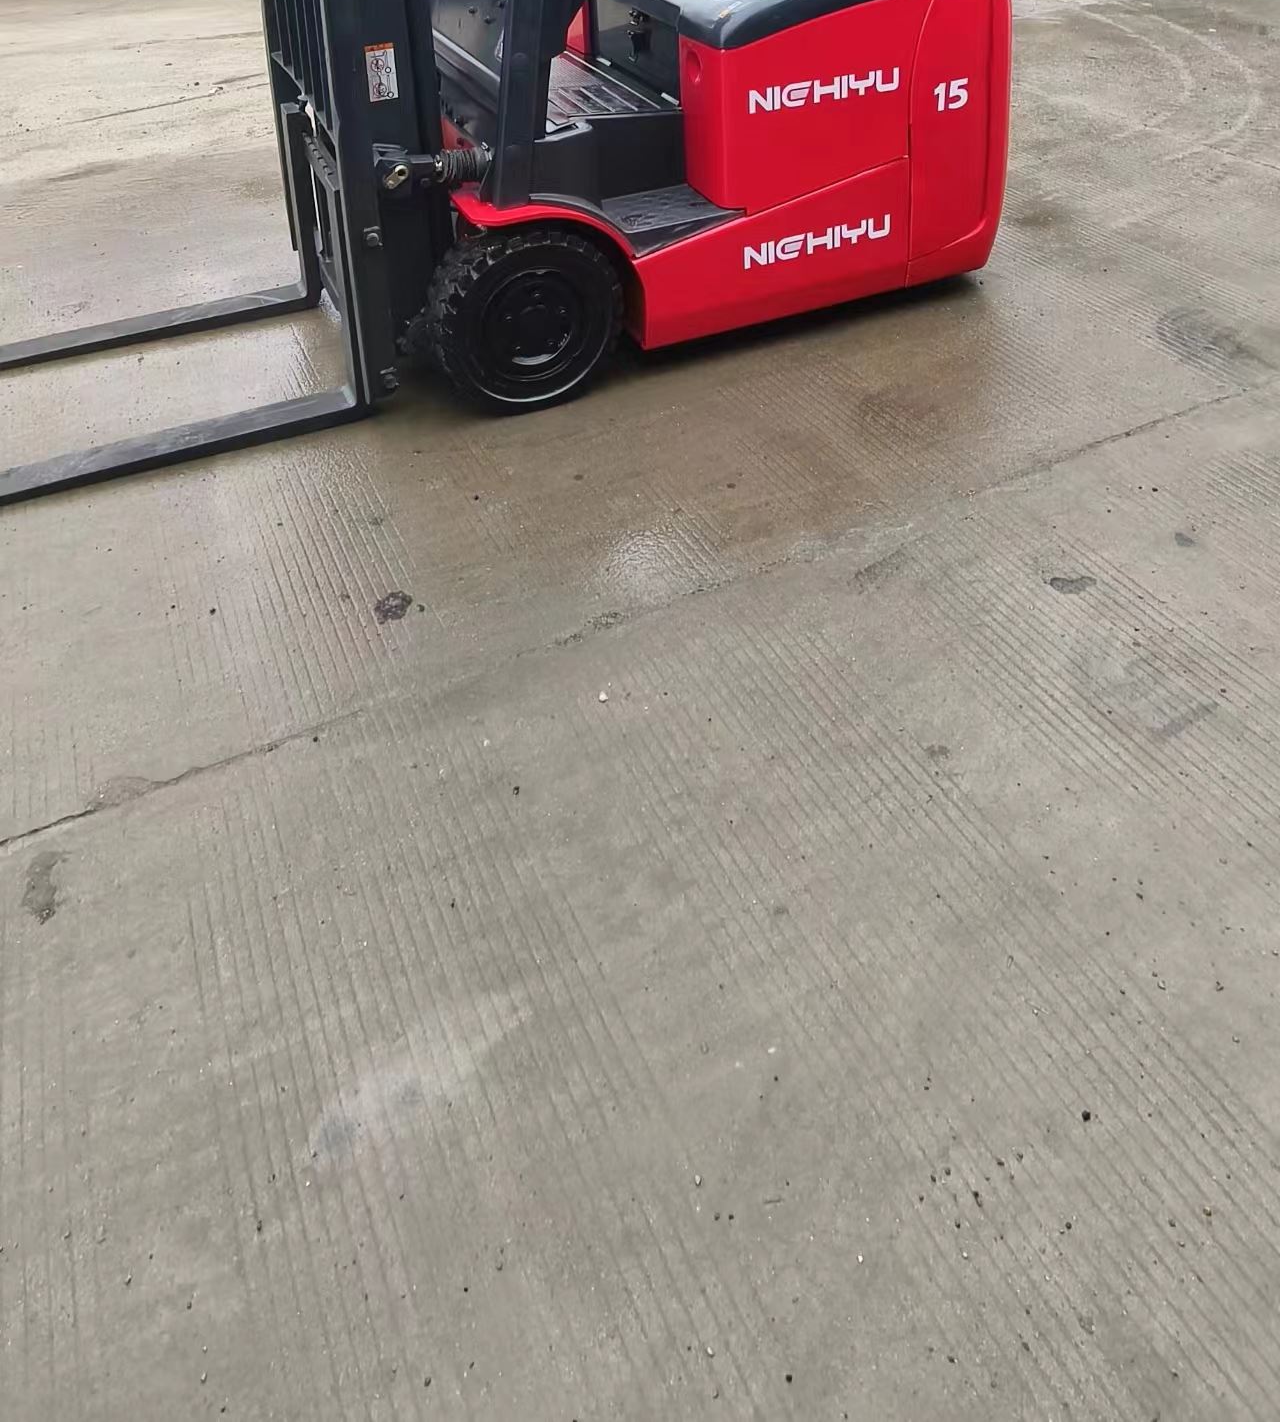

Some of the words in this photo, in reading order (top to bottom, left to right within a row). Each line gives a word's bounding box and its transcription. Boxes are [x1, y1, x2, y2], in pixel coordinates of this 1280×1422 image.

[749, 66, 900, 114] NICHIYU
[934, 77, 969, 111] 15
[743, 213, 891, 270] NICHIYU
